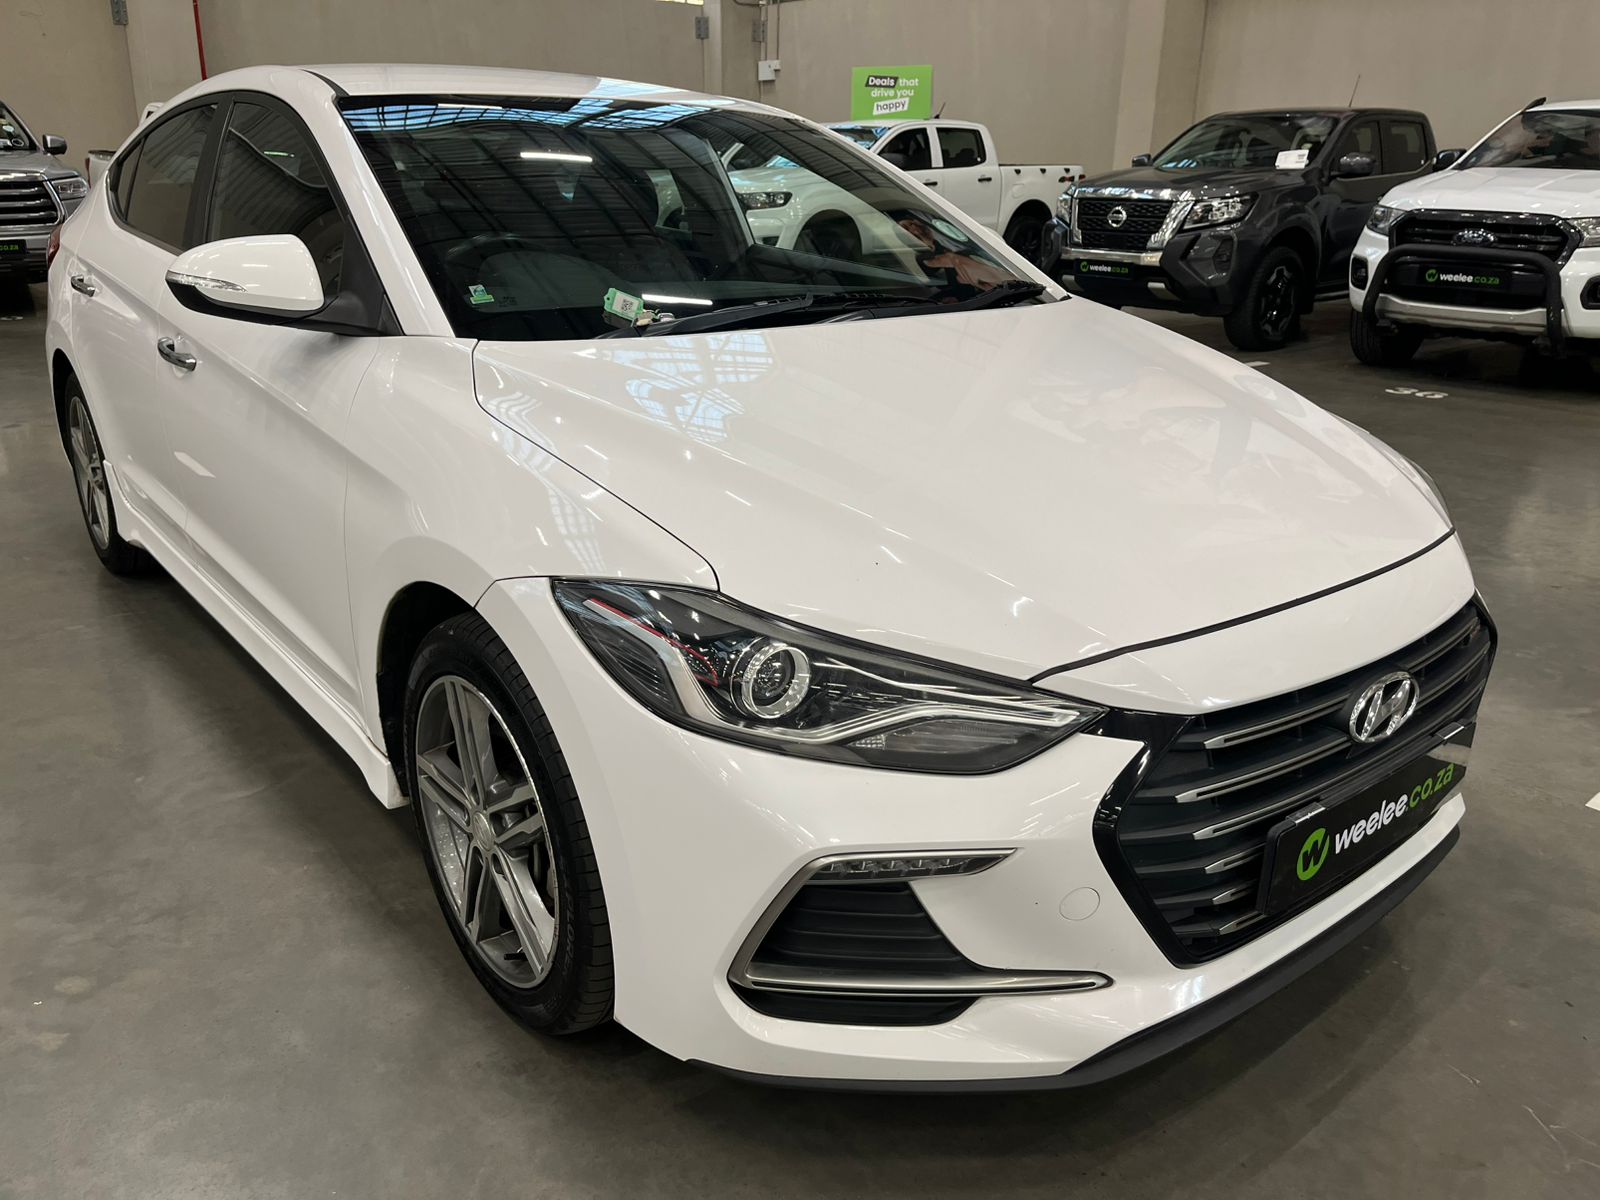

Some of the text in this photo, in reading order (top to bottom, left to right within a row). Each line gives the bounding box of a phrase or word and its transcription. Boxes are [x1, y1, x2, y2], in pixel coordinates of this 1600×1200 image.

[868, 77, 919, 87] Deals that
[871, 88, 914, 98] drive you
[876, 100, 906, 111] happy
[1089, 264, 1129, 274] weelee.co.za
[1439, 273, 1500, 285] weelee.co.za
[1335, 763, 1455, 854] weelee.co.za
